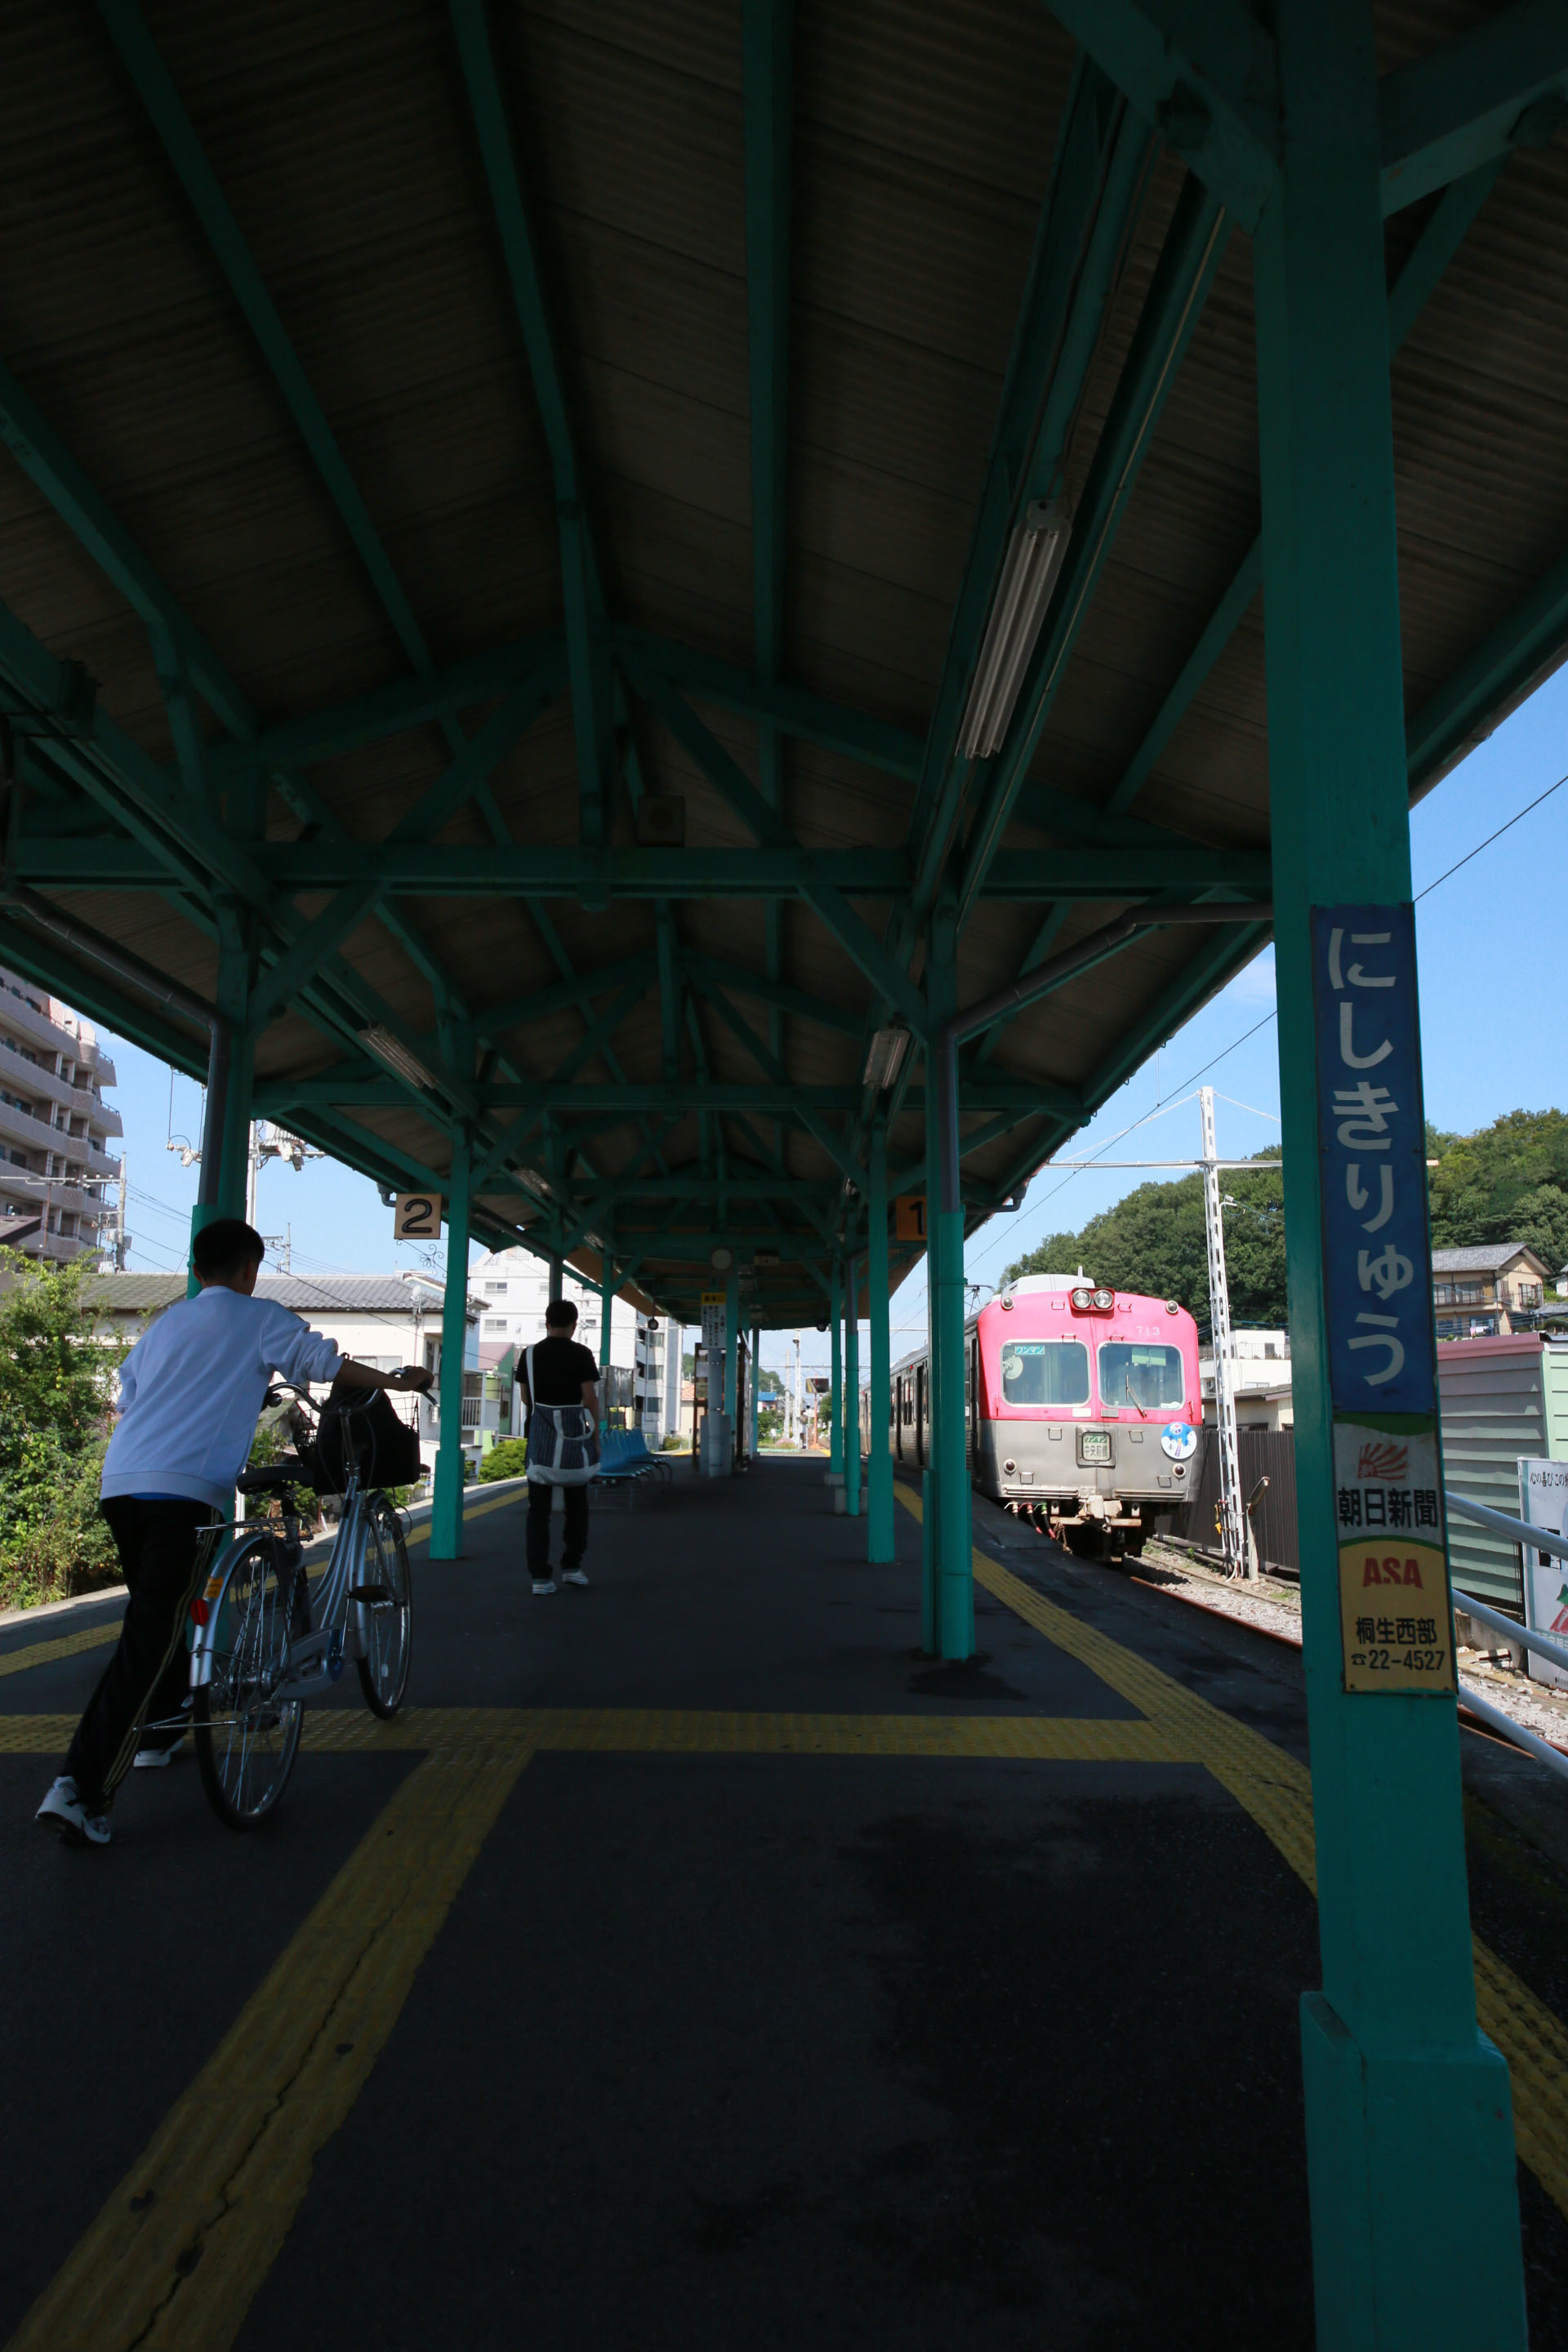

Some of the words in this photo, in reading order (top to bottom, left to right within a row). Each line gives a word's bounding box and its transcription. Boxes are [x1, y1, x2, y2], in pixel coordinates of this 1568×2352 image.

[1329, 928, 1414, 1386] にしきりゅう
[401, 1198, 433, 1233] 2
[909, 1200, 924, 1236] 1
[1136, 1325, 1160, 1335] 713
[1016, 1347, 1045, 1355] ワンマン
[1085, 1435, 1107, 1443] ワンマン
[1085, 1445, 1108, 1458] 中央前橋
[1338, 1487, 1438, 1528] 朝日新聞
[1362, 1557, 1424, 1590] ASA
[1356, 1616, 1437, 1645] 桐生西部
[1368, 1649, 1446, 1671] 22-4527
